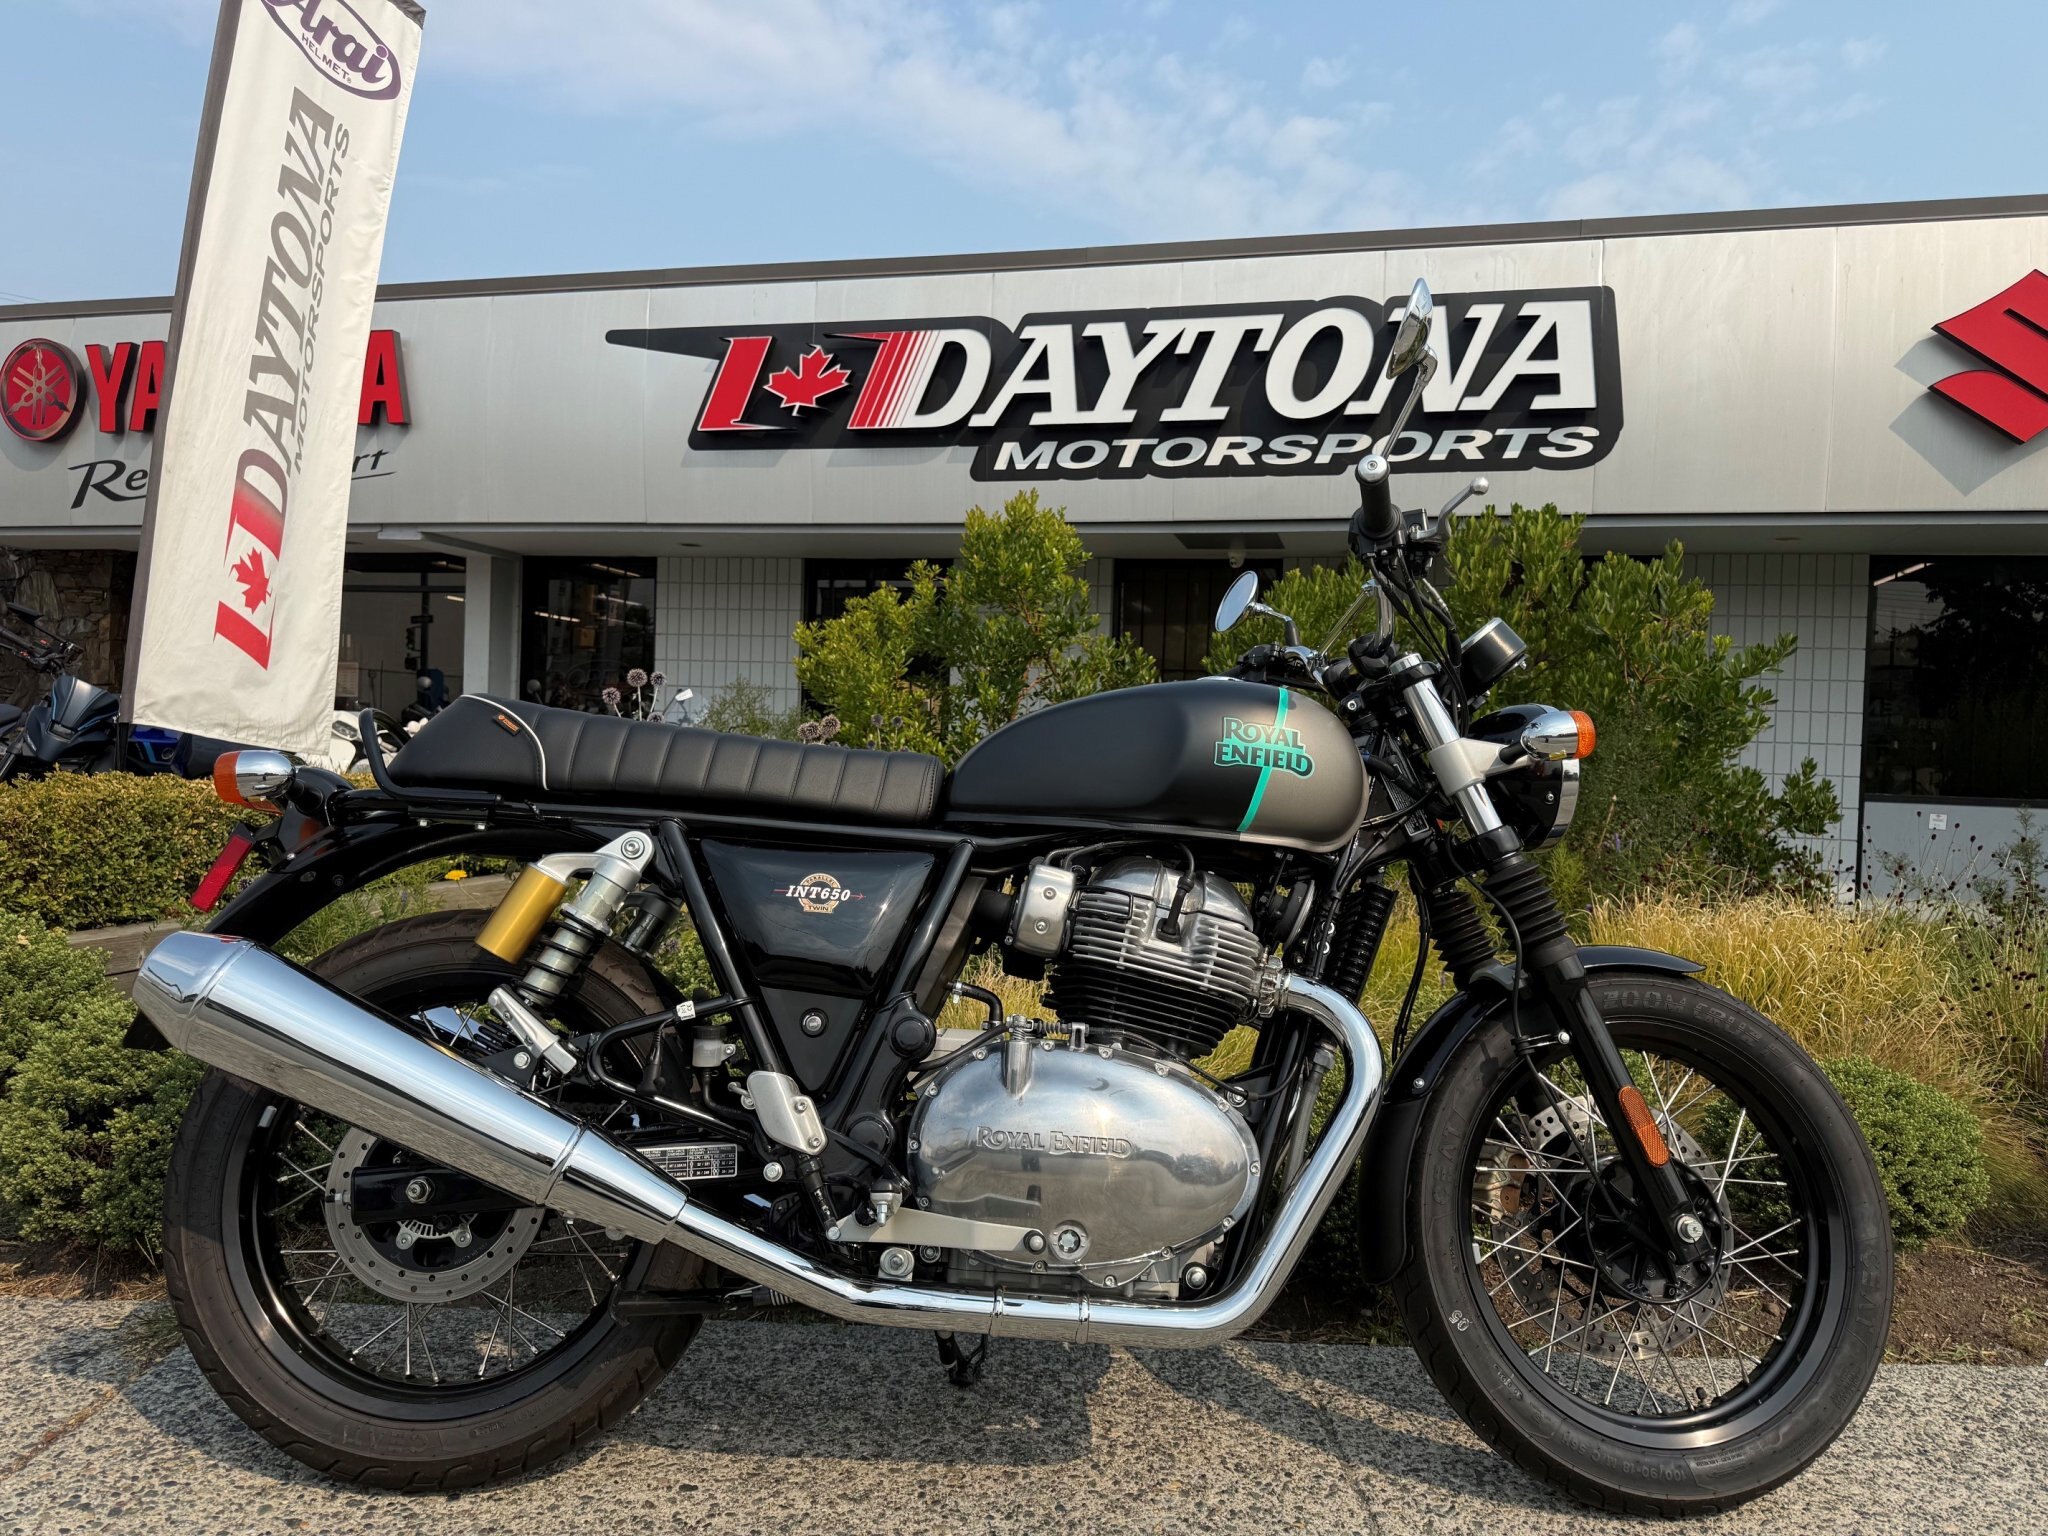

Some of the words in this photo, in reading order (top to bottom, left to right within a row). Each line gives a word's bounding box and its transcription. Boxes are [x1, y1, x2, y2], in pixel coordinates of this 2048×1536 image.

[265, 0, 388, 84] Arai
[301, 32, 350, 80] HELMET
[294, 123, 350, 475] MOTORSPORTS
[223, 86, 335, 568] DAYTONA
[828, 300, 1598, 430] DAYTONA
[993, 426, 1601, 472] MOTORSPORTS
[1224, 718, 1304, 749] ROYAL
[1216, 742, 1313, 777] ENFIELD
[786, 885, 851, 901] INT650
[976, 1125, 1046, 1151] ROYAL
[1048, 1130, 1133, 1159] ENFIELD
[1622, 1461, 1687, 1482] 100/90-18
